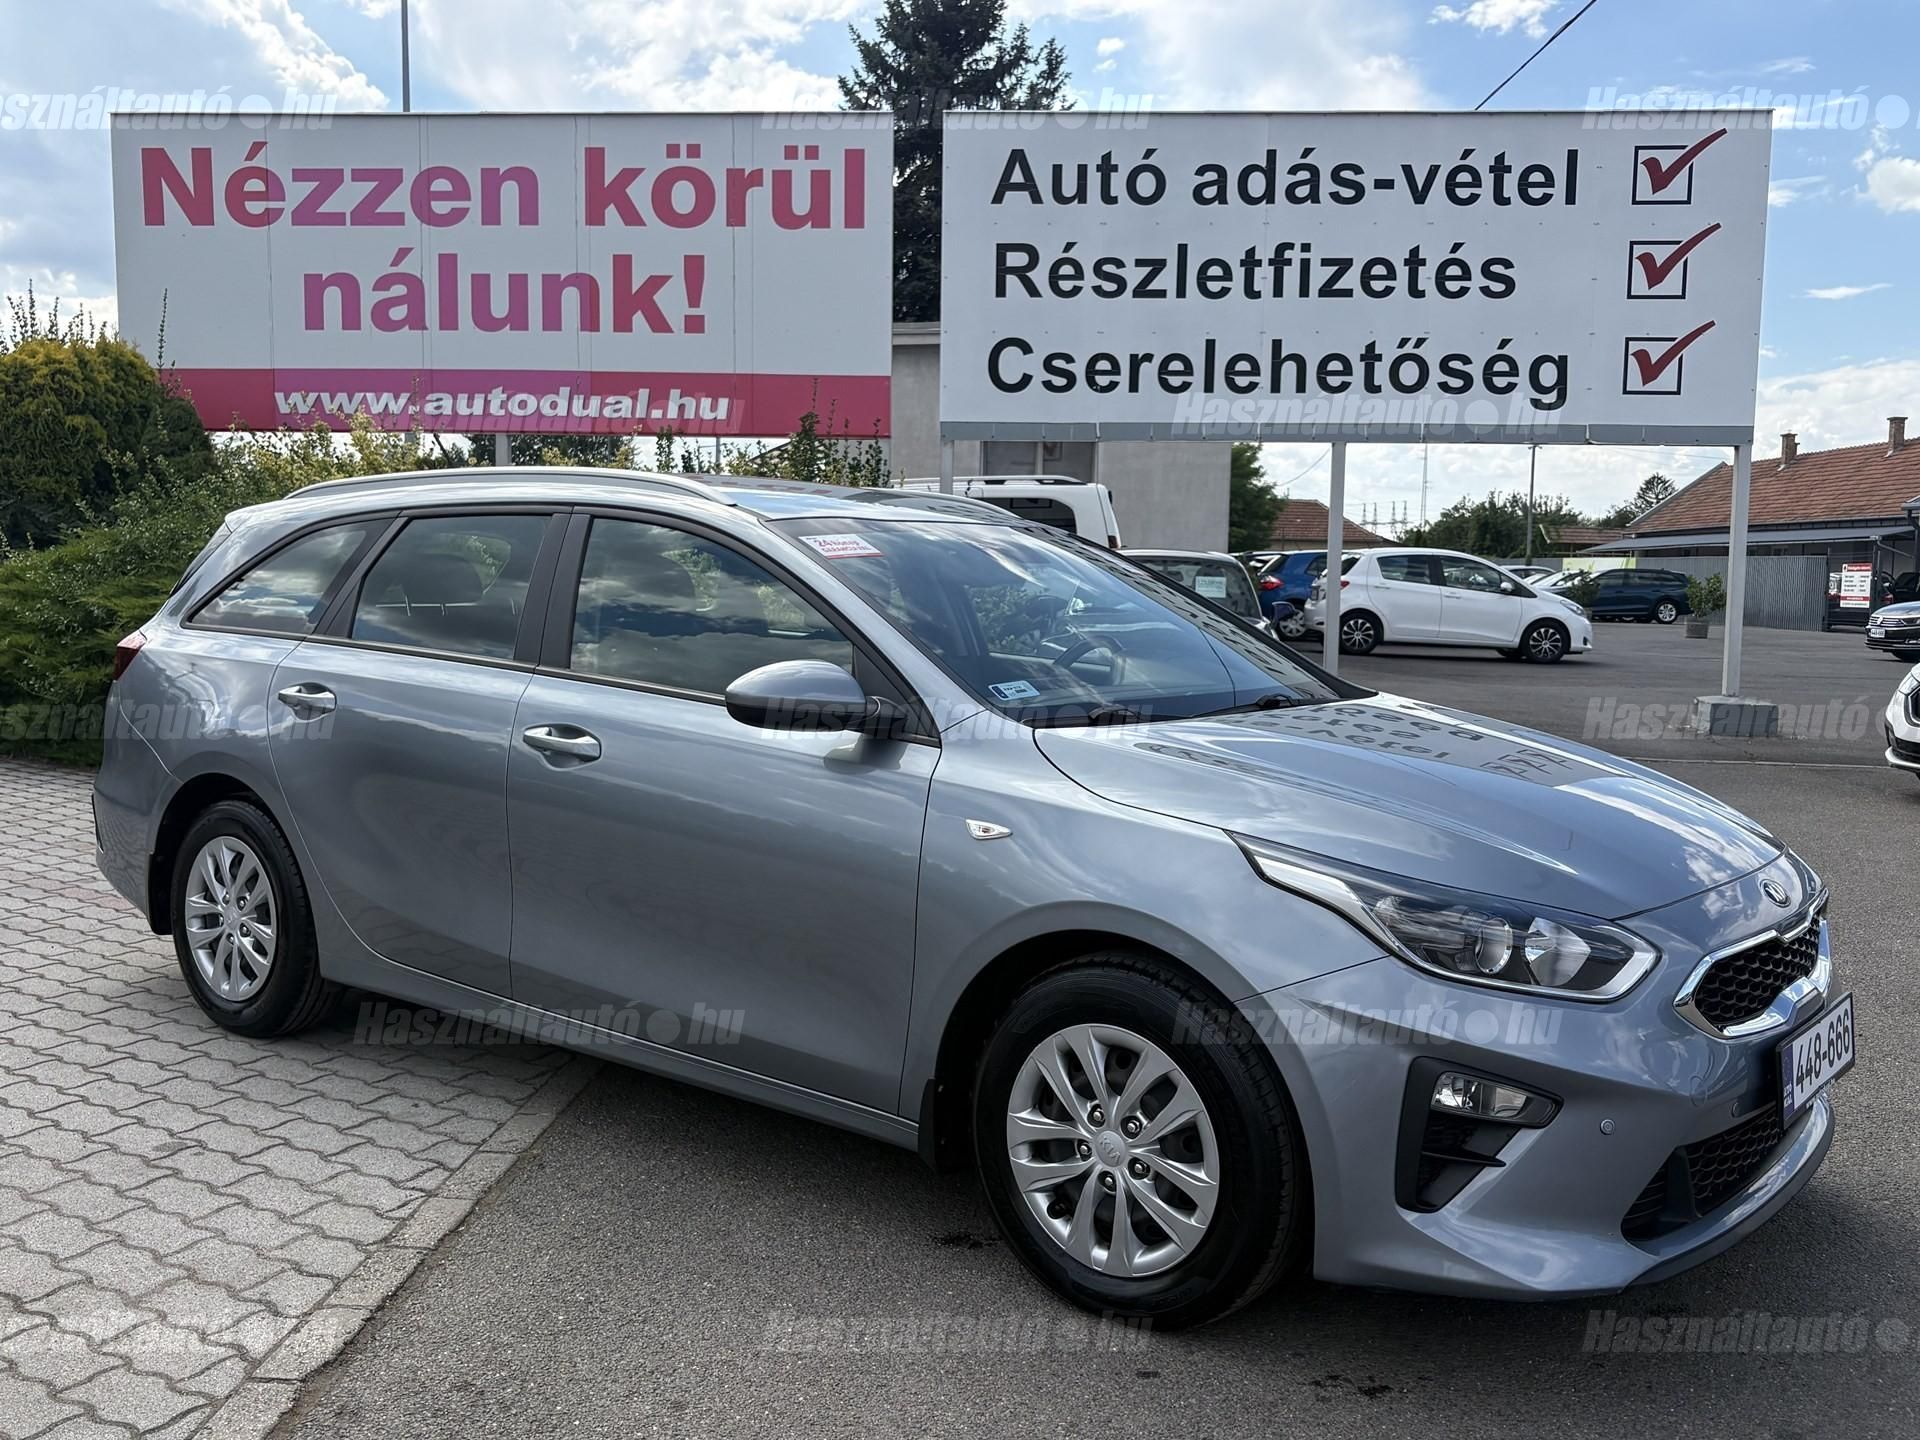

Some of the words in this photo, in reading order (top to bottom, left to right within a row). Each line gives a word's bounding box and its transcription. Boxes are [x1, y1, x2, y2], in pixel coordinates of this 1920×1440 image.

[141, 141, 540, 228] Nézzen
[584, 144, 866, 230] körül
[990, 147, 1167, 207] Autó
[1192, 147, 1579, 207] adás-vétel
[304, 248, 706, 334] nálunk!
[995, 241, 1516, 300] Részletfizetés
[274, 386, 730, 422] www.autodual.hu
[987, 337, 1569, 411] Cserelehetőség
[1795, 1008, 1851, 1094] 448-666
